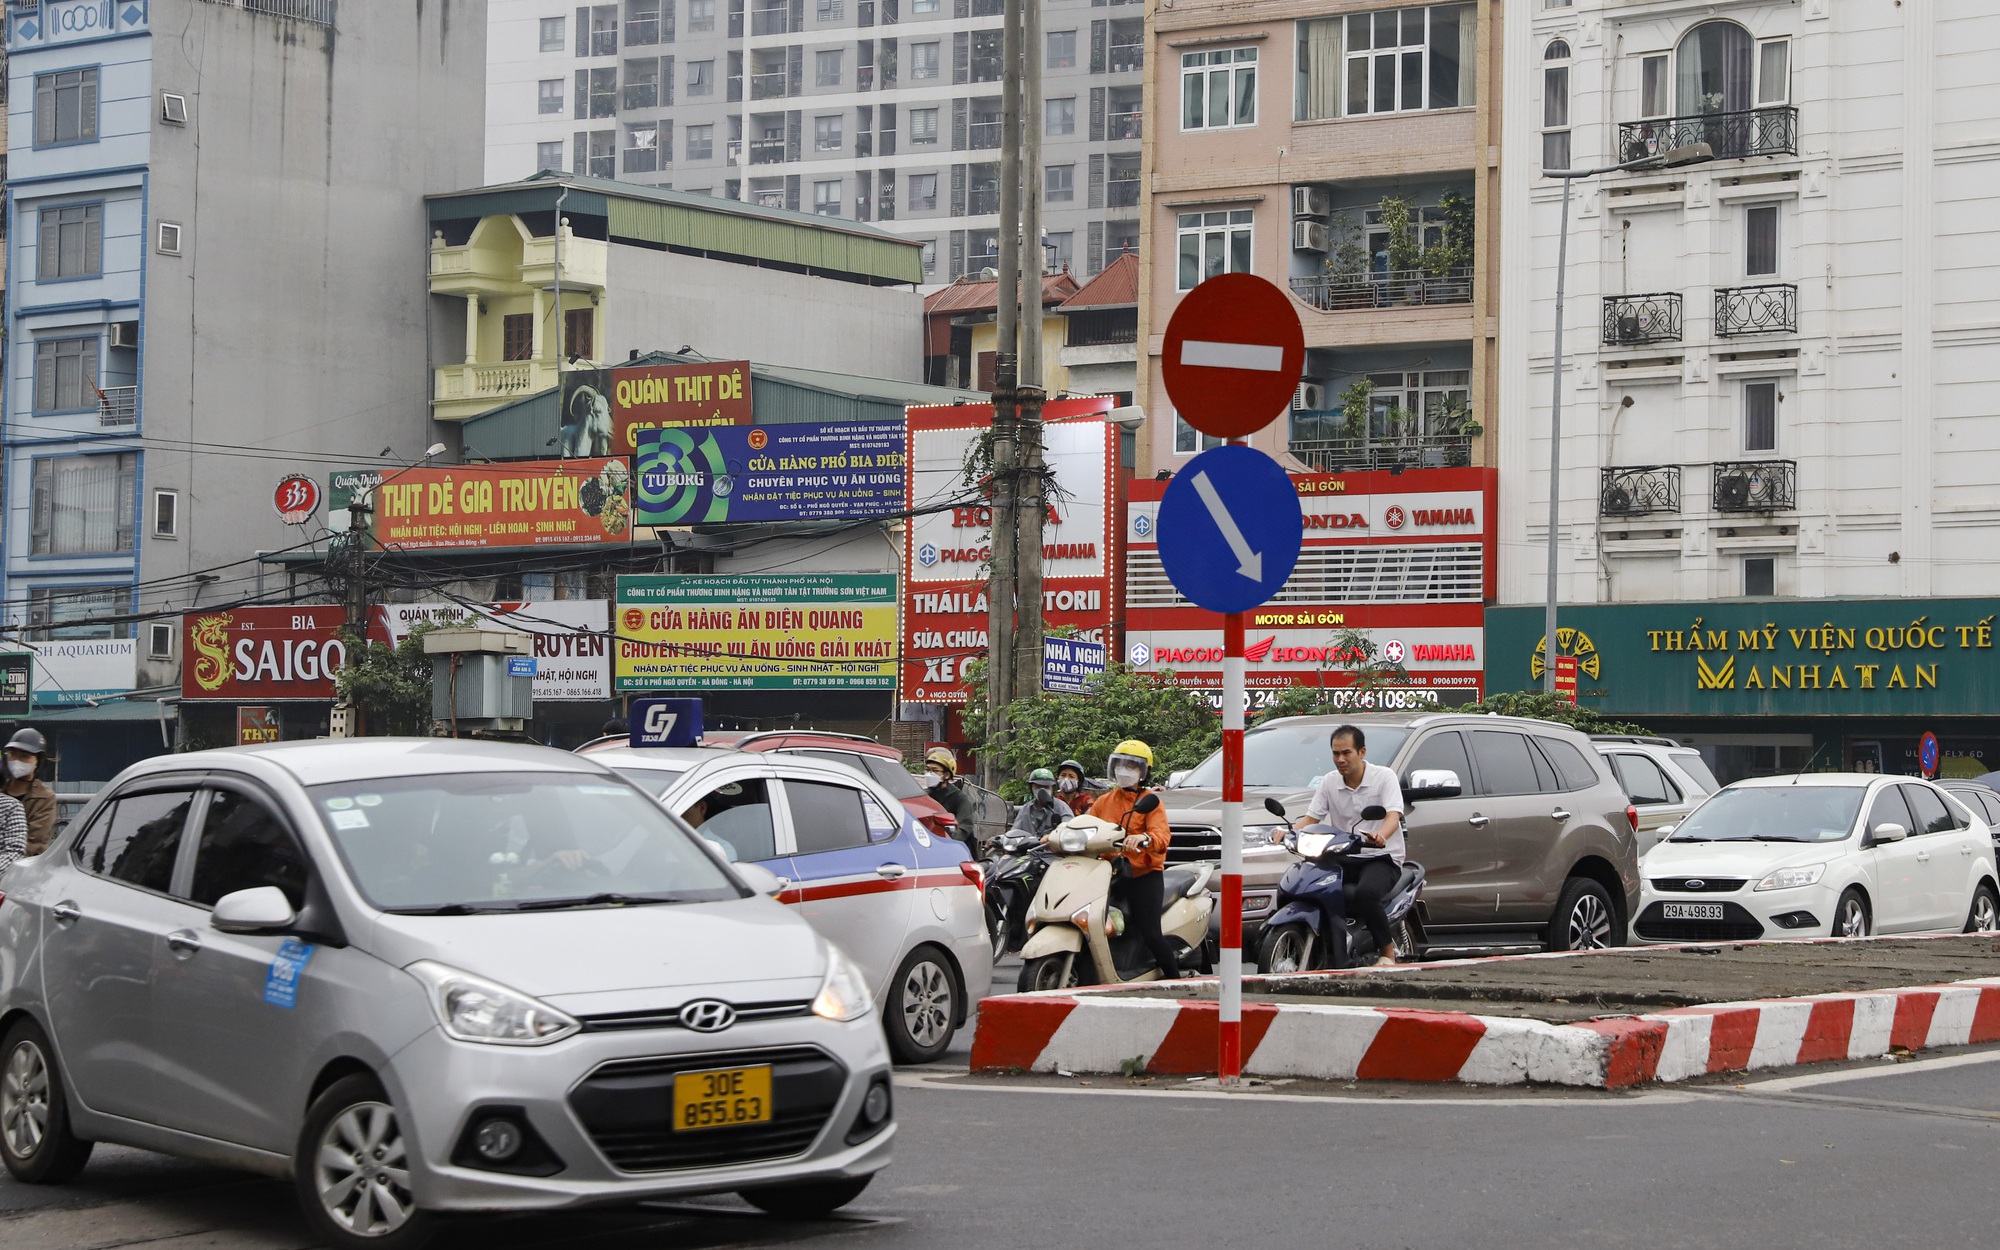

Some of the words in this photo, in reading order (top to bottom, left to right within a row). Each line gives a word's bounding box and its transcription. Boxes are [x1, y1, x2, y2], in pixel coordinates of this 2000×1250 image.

[616, 375, 668, 409] QUÁN
[677, 375, 712, 408] THỊT
[718, 368, 742, 399] DÊ
[749, 454, 776, 471] CỬA
[780, 454, 817, 470] HÀNG
[820, 450, 847, 469] PHỐ
[850, 456, 873, 468] BIA
[335, 474, 358, 488] Quán
[646, 472, 704, 488] TUBORG
[748, 476, 794, 488] CHUYÊN
[798, 477, 828, 488] PHỤC
[832, 476, 847, 487] VỤ
[851, 474, 867, 484] ĂN
[1298, 480, 1316, 492] SÀI
[1319, 477, 1346, 492] GÒN
[284, 481, 308, 510] 333
[382, 482, 423, 524] THỊT
[429, 474, 453, 515] DÊ
[460, 480, 492, 514] GIA
[500, 464, 578, 512] TRUYỀN
[742, 492, 765, 502] NHẬN
[767, 492, 782, 502] ĐẶT
[785, 491, 801, 500] TIỆC
[804, 492, 824, 500] PHỤC
[826, 492, 836, 500] VỤ
[838, 490, 850, 498] ĂN
[852, 487, 874, 498] UỐNG
[952, 505, 1062, 528] HOA
[1302, 514, 1369, 529] ONDA
[1412, 508, 1475, 526] YAMAHA
[390, 526, 411, 540] NHẬN
[412, 524, 427, 539] ĐẶT
[429, 524, 448, 538] TIỆC:
[449, 522, 462, 538] HỘI
[464, 524, 482, 536] NGHỊ
[489, 520, 506, 534] LIÊN
[508, 522, 528, 534] HOAN
[536, 521, 554, 532] SINH
[556, 520, 576, 534] NHẬT
[940, 548, 991, 562] PIAGG
[1042, 544, 1096, 559] YAMAHA
[820, 576, 834, 584] NỘI
[627, 587, 646, 596] CÔNG
[647, 588, 654, 596] TY
[656, 586, 666, 596] CỔ
[667, 586, 684, 596] PHẦN
[686, 588, 712, 596] THƯƠNG
[714, 588, 730, 596] BINH
[732, 587, 750, 598] NẶNG
[752, 586, 761, 596] VÀ
[762, 586, 782, 596] NGƯỜI
[784, 586, 798, 596] TÀN
[799, 586, 811, 597] TẬT
[812, 586, 838, 596] TRƯỜNG
[840, 587, 854, 596] SƠN
[856, 586, 870, 596] VIỆT
[871, 587, 887, 596] NAM
[913, 590, 960, 614] THÁI
[963, 592, 990, 612] LA
[400, 606, 429, 622] QUÁN
[651, 606, 682, 630] CỬA
[688, 608, 732, 630] HÀNG
[738, 607, 760, 630] ĂN
[765, 608, 802, 633] ĐIỆN
[808, 610, 863, 630] QUANG
[1255, 613, 1294, 626] MOTOR
[1297, 611, 1314, 625] SÀI
[1318, 610, 1344, 625] GÒN
[241, 622, 256, 631] EST.
[292, 616, 316, 630] BIA
[530, 624, 604, 658] RUYỀN
[913, 628, 944, 648] SỬA
[946, 627, 988, 648] CHỮA
[1648, 617, 1728, 652] THẨM
[1738, 621, 1779, 650] MỸ
[1788, 622, 1856, 656] VIỆN
[1865, 615, 1944, 652] QUỐC
[1956, 614, 1996, 648] TẾ
[36, 646, 53, 656] SH
[57, 644, 132, 658] AQUARIUM
[621, 640, 678, 658] CHUYÊN
[684, 642, 723, 661] PHỤC
[728, 642, 746, 661] VỤ
[750, 638, 770, 658] ĂN
[776, 636, 816, 658] UỐNG
[820, 636, 850, 658] GIẢI
[854, 638, 892, 658] KHÁT
[1046, 642, 1071, 661] NHÀ
[1076, 645, 1105, 666] NGHỈ
[1154, 648, 1224, 662] PIAGGIO
[1272, 646, 1368, 662] HONDA
[1412, 644, 1476, 662] YAMAHA
[235, 640, 346, 682] SAIGO
[634, 664, 658, 674] NHẬN
[660, 664, 678, 674] ĐẶT
[680, 664, 698, 674] TIỆC
[700, 665, 724, 674] PHỤC
[726, 665, 738, 674] VỤ
[740, 664, 752, 672] ĂN
[754, 662, 780, 672] UỐNG
[787, 664, 808, 672] SINH
[810, 662, 834, 674] NHẬT
[841, 662, 856, 674] HỘI
[858, 664, 878, 674] NGHỊ
[1048, 662, 1066, 672] AN
[534, 670, 556, 684] NHẬT,
[558, 668, 574, 682] HỘI
[576, 670, 598, 683] NGHỊ
[923, 658, 954, 683] XE
[624, 678, 634, 686] ĐC:
[644, 678, 648, 686] 6
[650, 677, 661, 686] PHỐ
[663, 678, 676, 686] NGÔ
[677, 676, 696, 686] QUYỀN
[702, 678, 710, 686] HÀ
[712, 678, 728, 686] ĐÔNG
[734, 678, 742, 686] HÀ
[743, 677, 754, 686] NỘI
[1206, 678, 1220, 686] VẠN
[1256, 676, 1272, 685] (CƠ
[1272, 675, 1282, 684] SỞ
[1284, 676, 1292, 684] 3)
[532, 688, 562, 696] 915.415.167
[566, 688, 602, 696] 0865.166.418
[644, 704, 678, 742] G7
[242, 728, 278, 743] THỊT
[1664, 905, 1722, 918] 29A-498.93
[703, 1071, 744, 1098] 30E
[684, 1096, 762, 1126] 855.63
